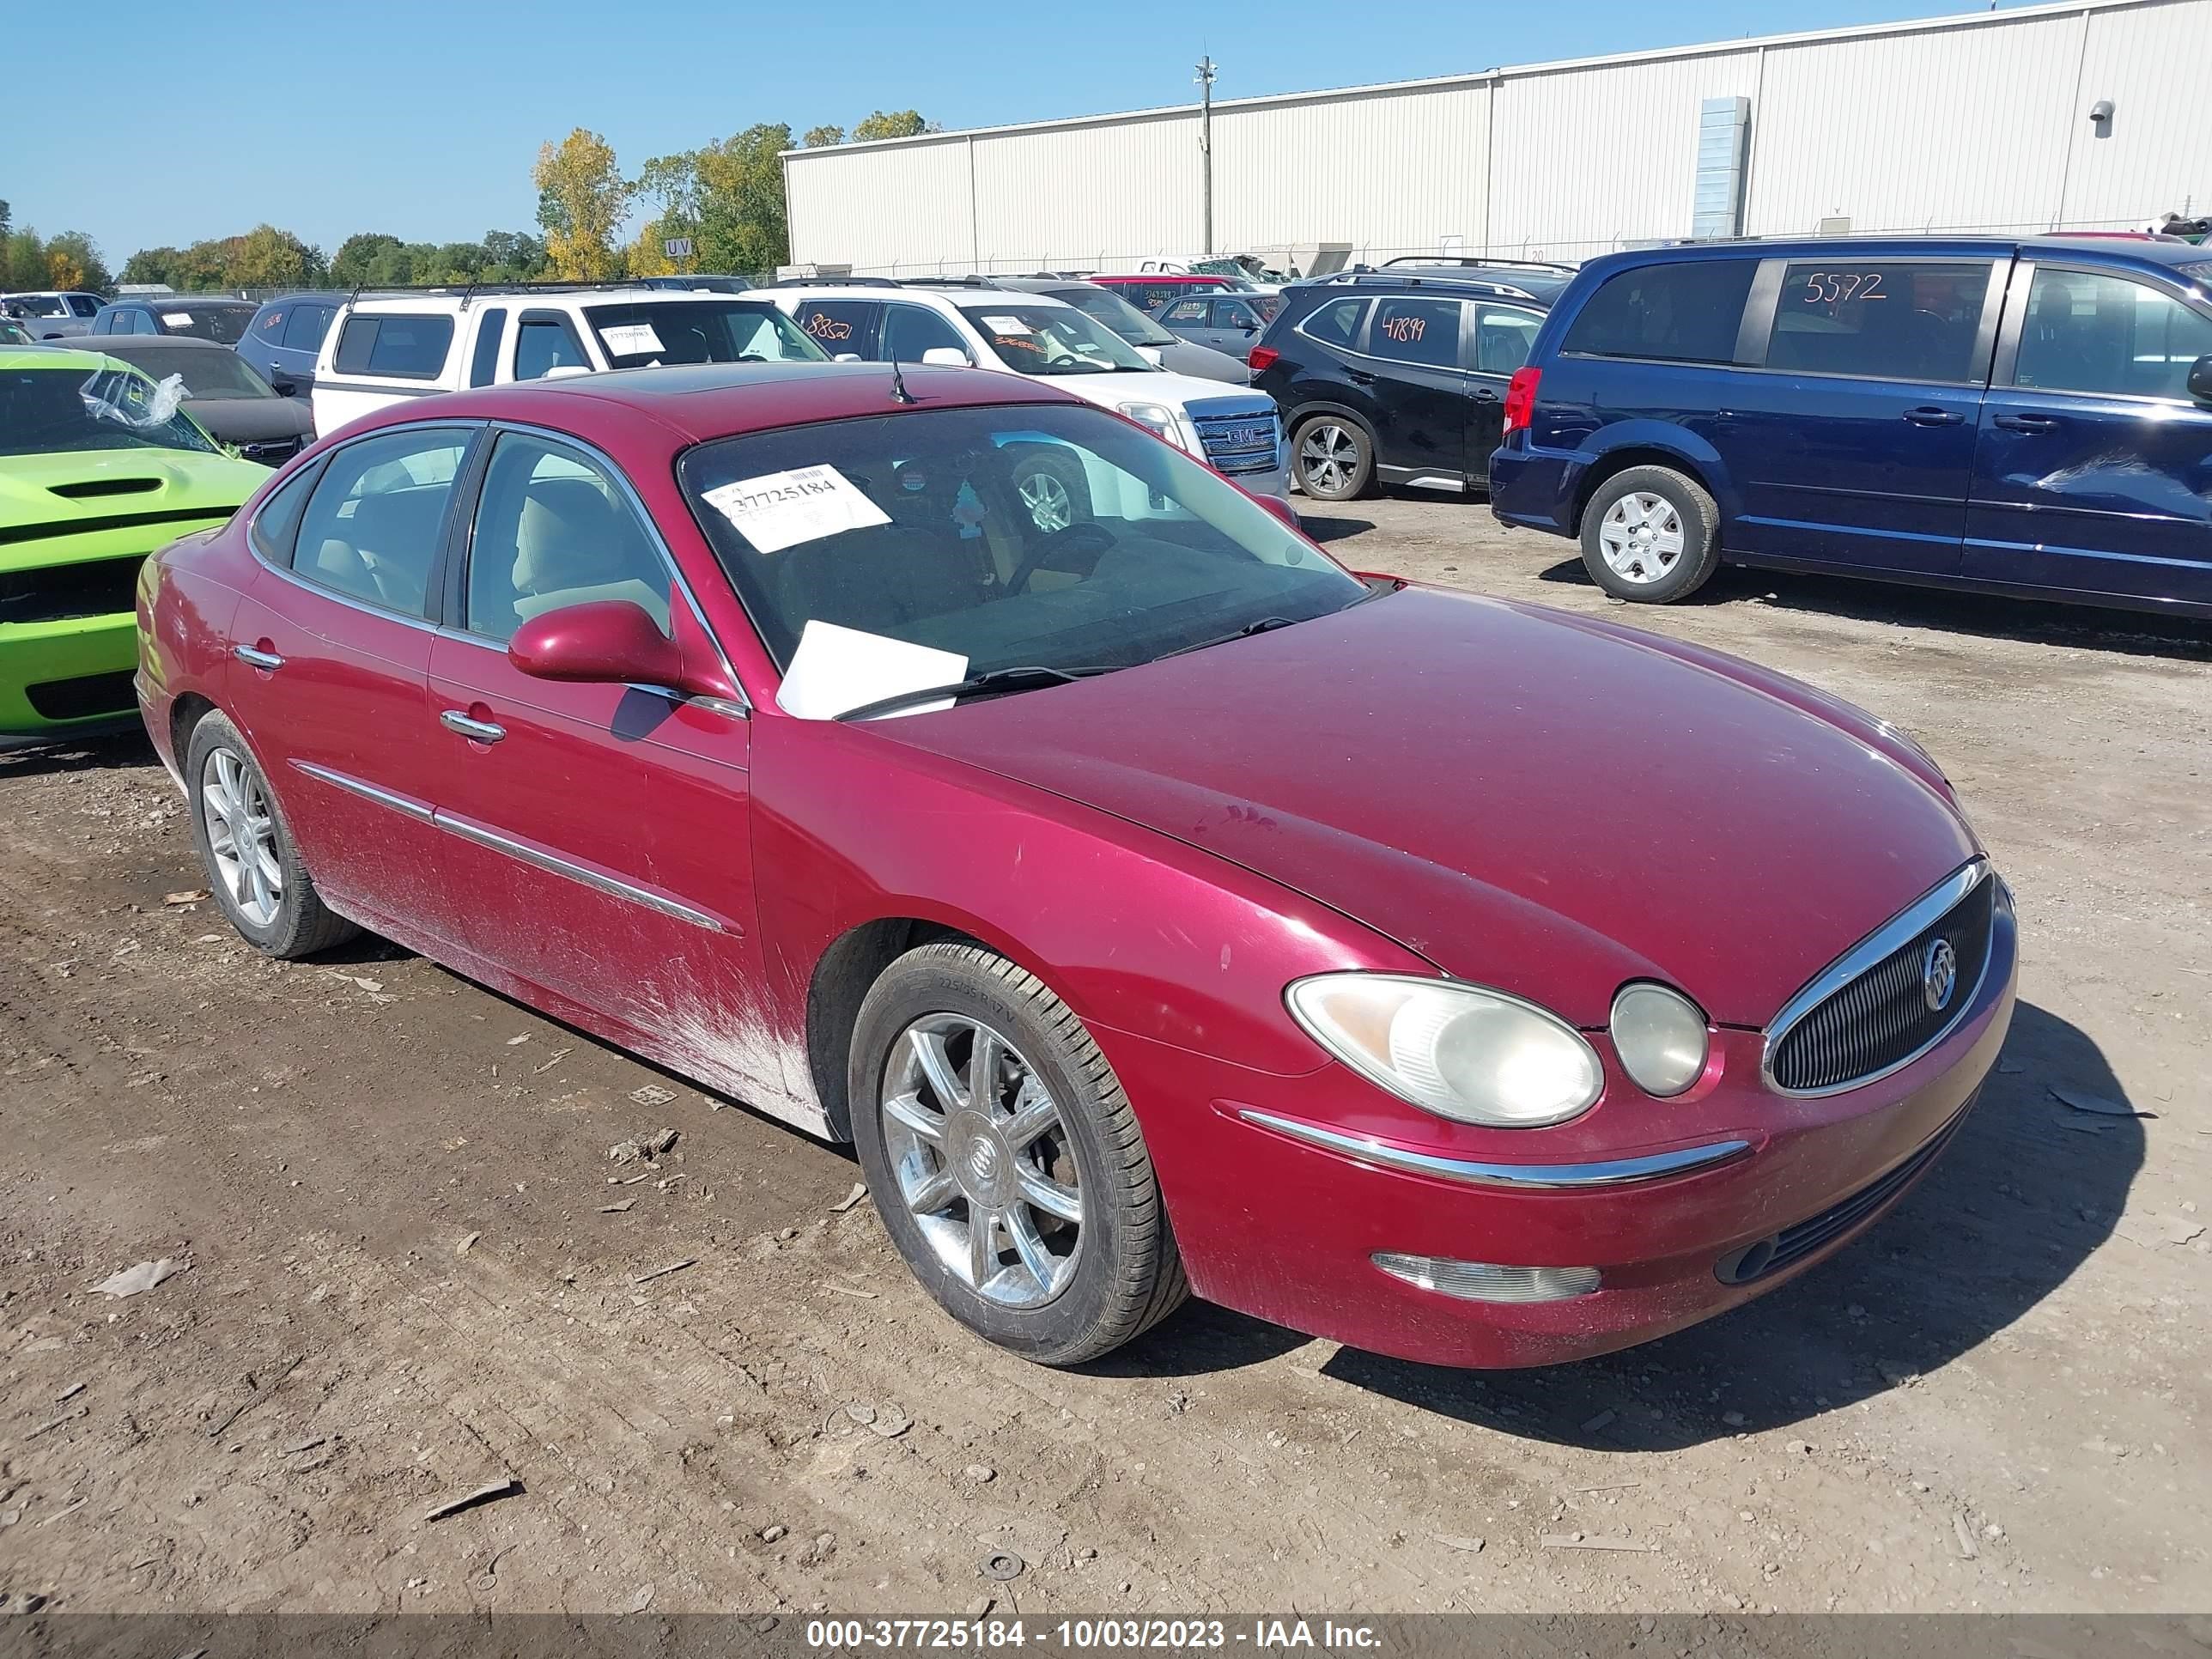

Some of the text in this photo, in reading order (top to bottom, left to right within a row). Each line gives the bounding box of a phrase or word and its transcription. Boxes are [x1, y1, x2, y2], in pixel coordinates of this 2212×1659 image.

[1804, 273, 1887, 302] 5572
[1382, 314, 1425, 342] 47899
[1227, 428, 1264, 443] GMC
[732, 480, 837, 513] 37725184
